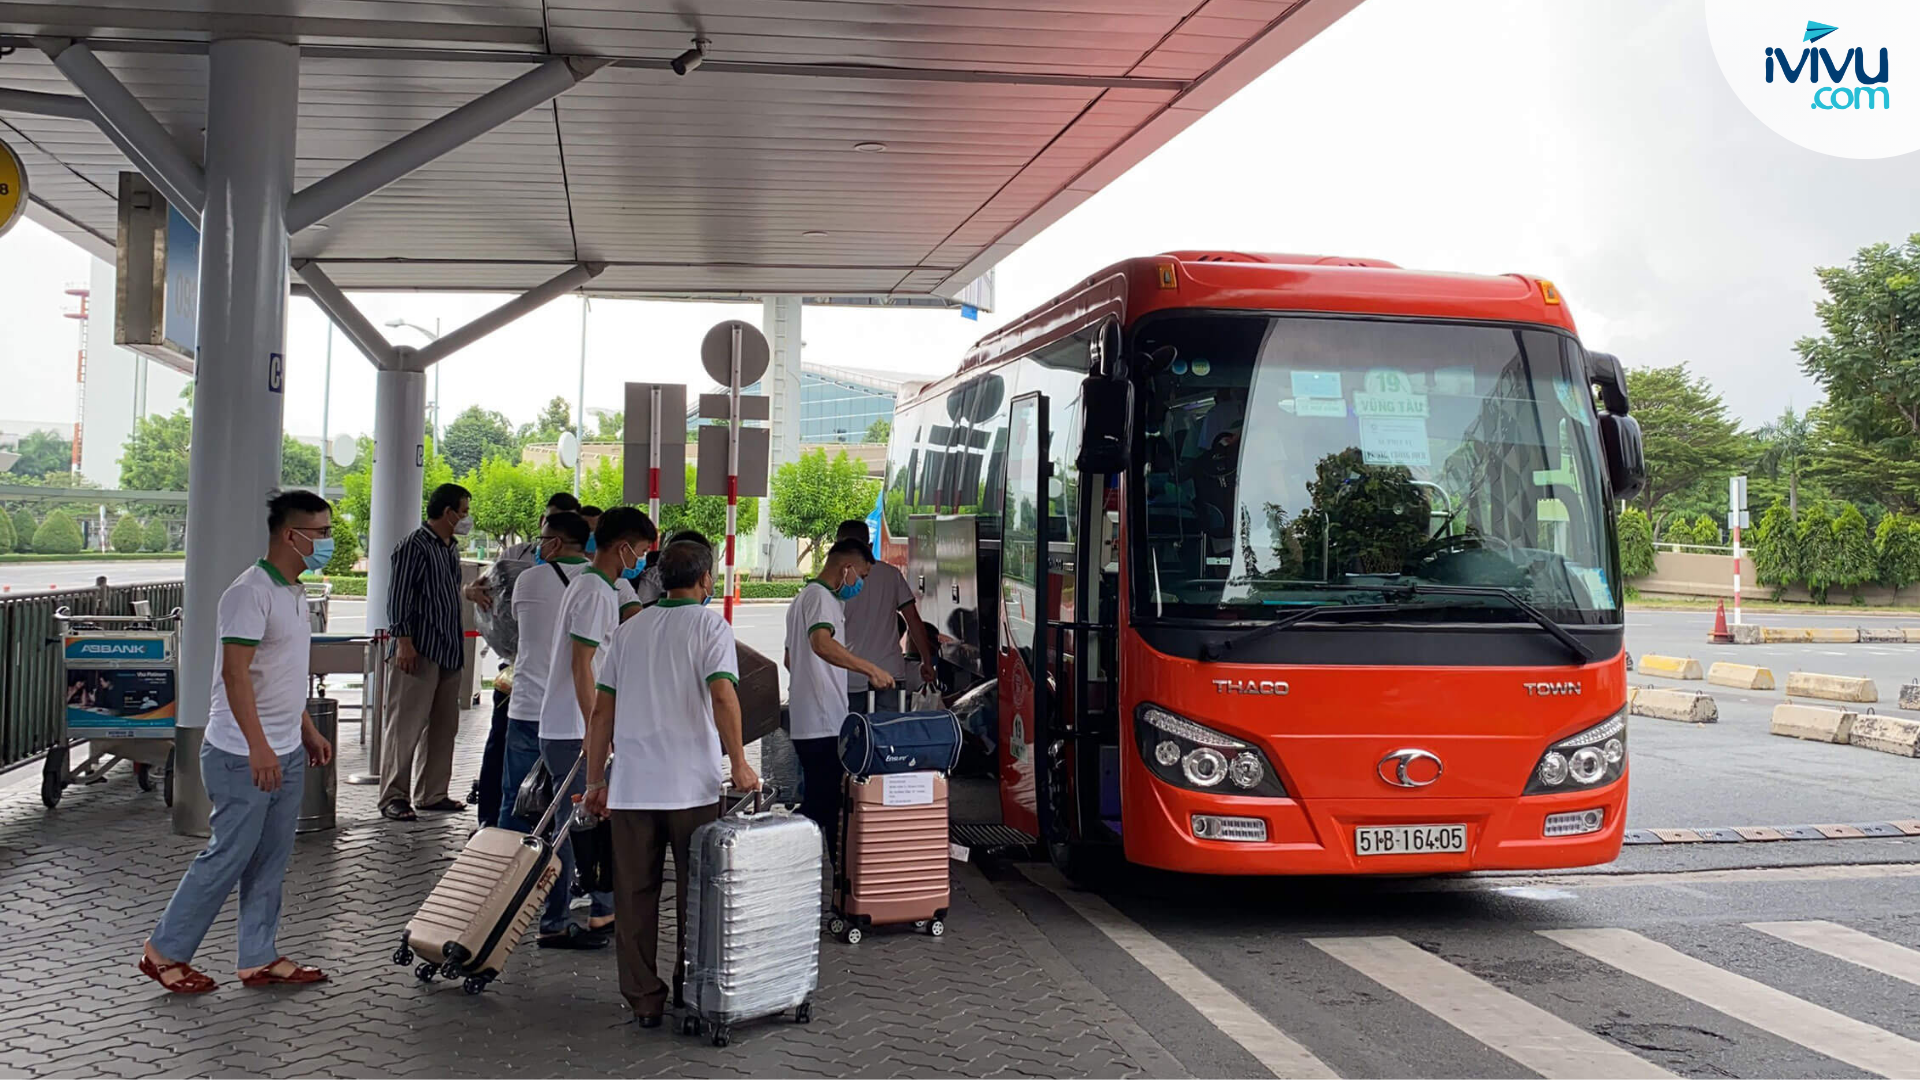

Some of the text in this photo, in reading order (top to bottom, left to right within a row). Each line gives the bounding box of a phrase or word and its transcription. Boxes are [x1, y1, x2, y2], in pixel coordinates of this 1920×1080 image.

[1375, 371, 1400, 393] 19
[1212, 679, 1290, 695] THACO
[1523, 682, 1582, 696] TOWN
